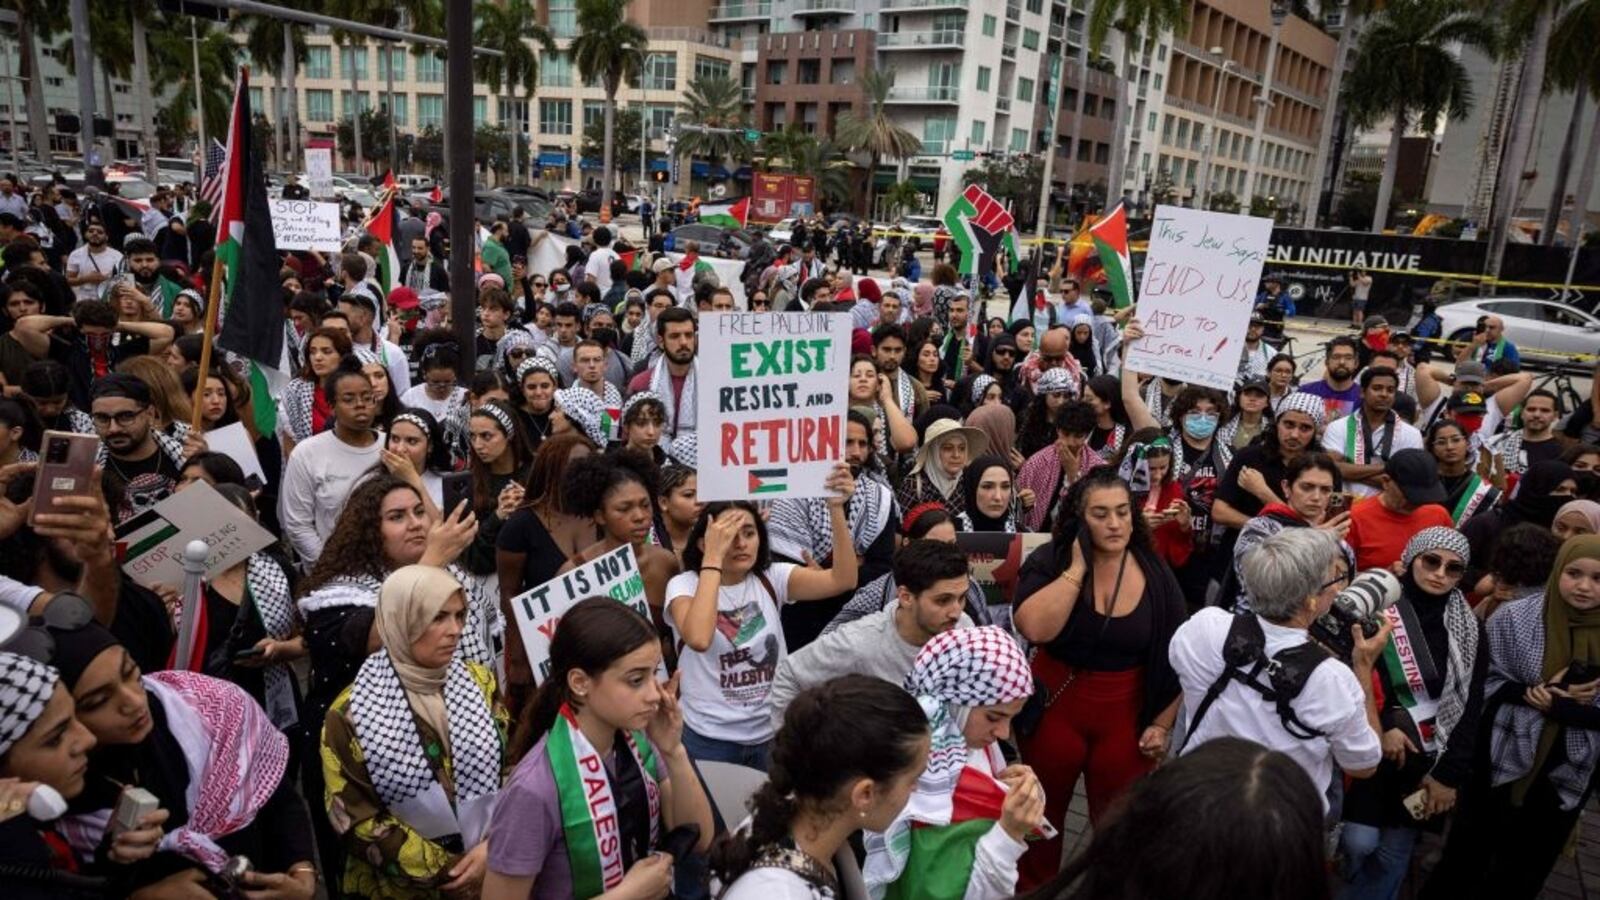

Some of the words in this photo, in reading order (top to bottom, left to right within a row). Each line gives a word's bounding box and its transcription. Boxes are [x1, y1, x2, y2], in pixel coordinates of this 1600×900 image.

[276, 201, 318, 214] STOP
[1157, 217, 1188, 243] This
[1192, 223, 1224, 250] Jew
[1266, 244, 1292, 261] EN
[1296, 245, 1422, 271] INITIATIVE
[719, 313, 763, 335] FREE
[771, 312, 834, 335] PALESTINE
[1144, 309, 1185, 330] AID
[1194, 316, 1218, 332] TO
[805, 393, 834, 407] AND
[721, 415, 840, 467] RETURN
[132, 545, 171, 575] STOP
[521, 585, 551, 621] IT
[562, 569, 591, 601] IS
[593, 545, 633, 586] NOT
[719, 647, 753, 672] FREE
[1386, 602, 1425, 693] PALESTINE
